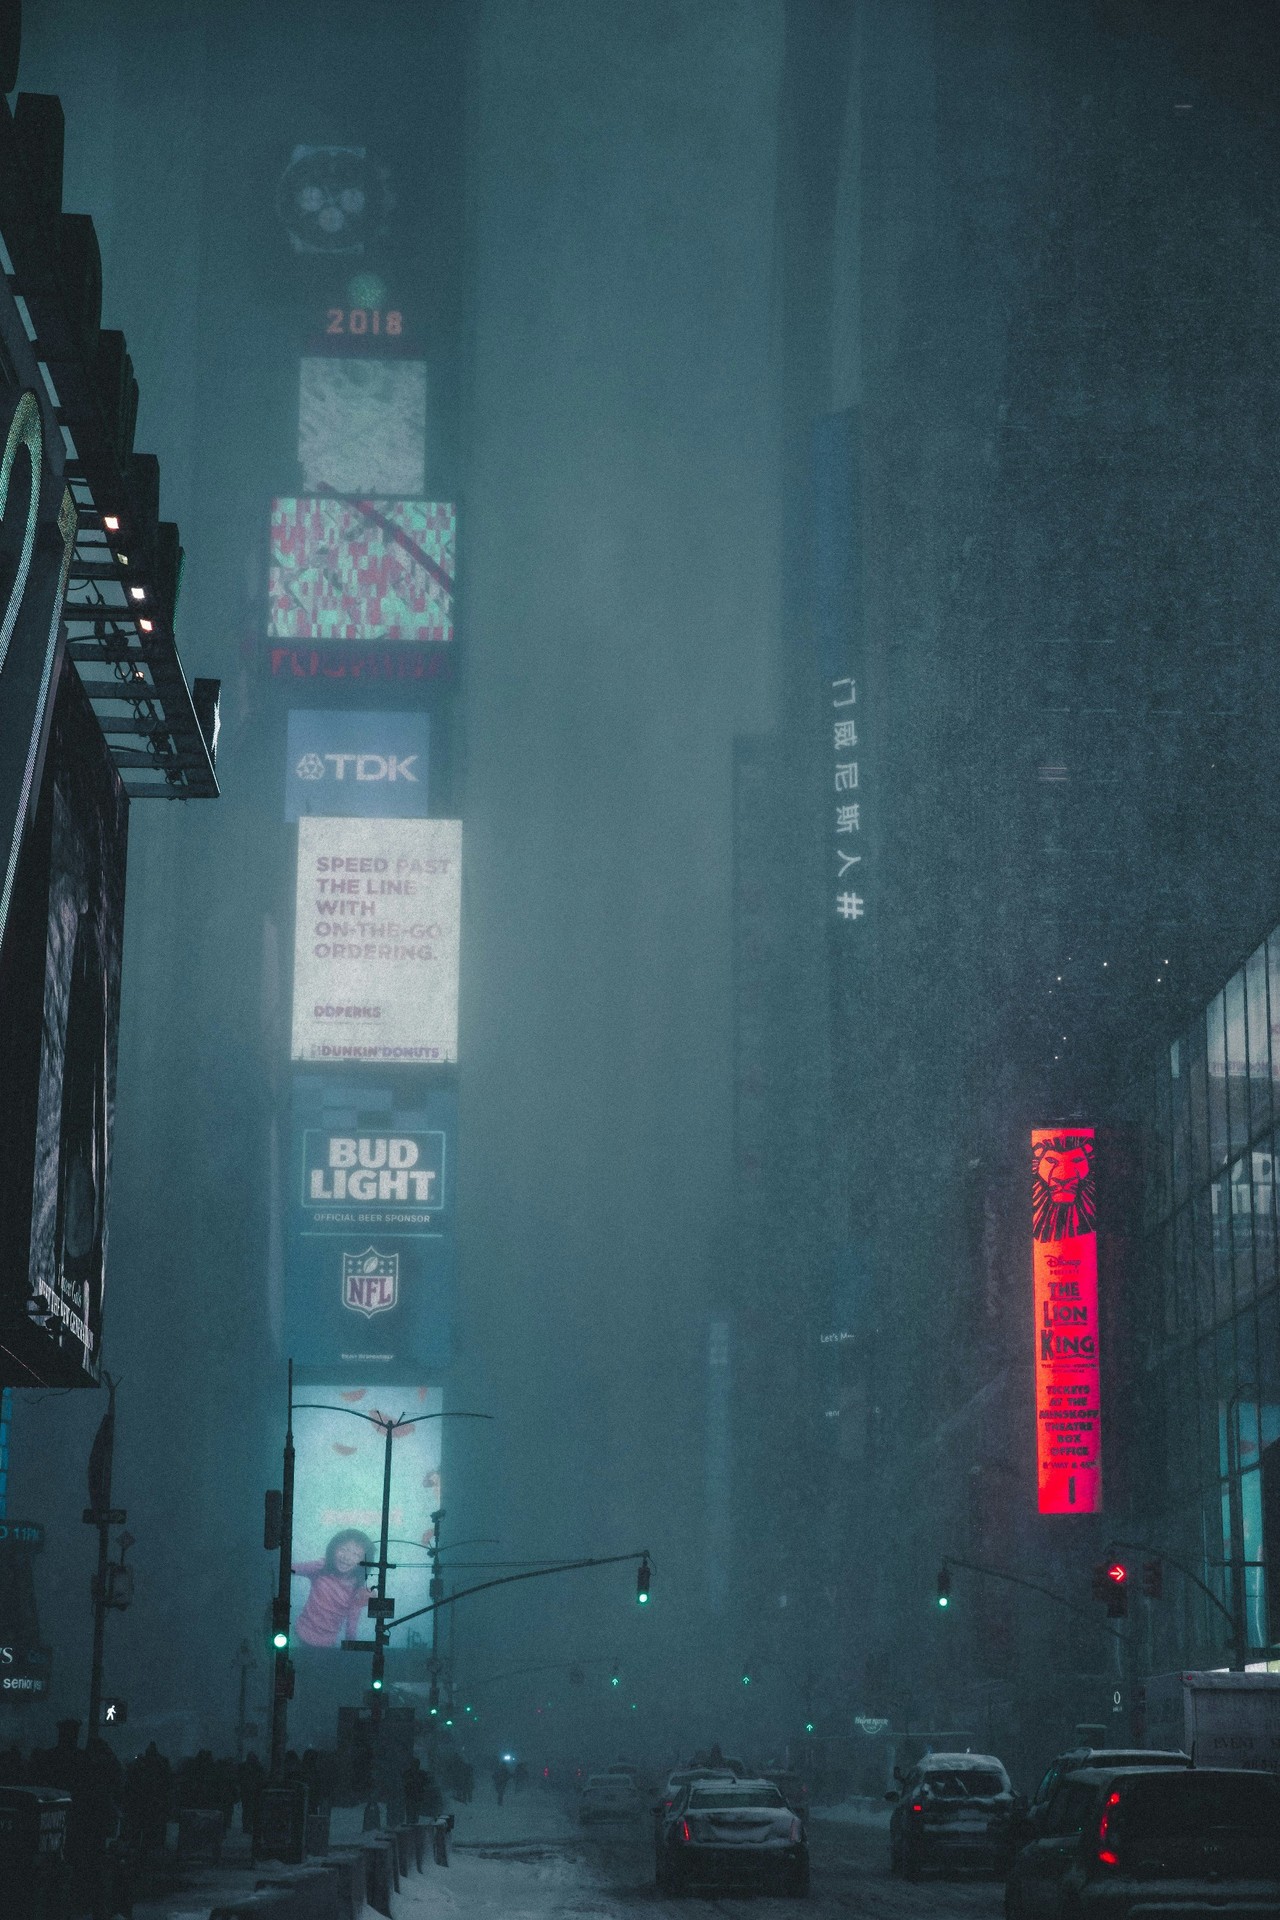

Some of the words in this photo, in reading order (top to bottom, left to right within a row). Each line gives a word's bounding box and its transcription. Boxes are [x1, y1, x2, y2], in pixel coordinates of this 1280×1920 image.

[326, 309, 402, 335] 2018
[325, 754, 419, 782] TDK
[316, 856, 388, 873] SPEED
[396, 858, 450, 875] PAST
[316, 878, 360, 894] THE
[366, 879, 417, 895] LINE
[316, 900, 376, 916] WITH
[329, 1138, 419, 1168] BUD
[310, 1169, 436, 1201] LIGHT
[313, 1213, 355, 1222] OFFICIAL
[358, 1214, 383, 1222] BEER
[385, 1214, 431, 1223] SPONSOR
[349, 1277, 392, 1307] NFL
[1048, 1282, 1080, 1297] THE
[1043, 1301, 1088, 1328] LION
[1041, 1329, 1095, 1361] KING
[1046, 1385, 1090, 1394] TICKETS
[1067, 1398, 1088, 1406] THE
[1057, 1434, 1082, 1443] BOX
[1051, 1447, 1089, 1456] OFFICE
